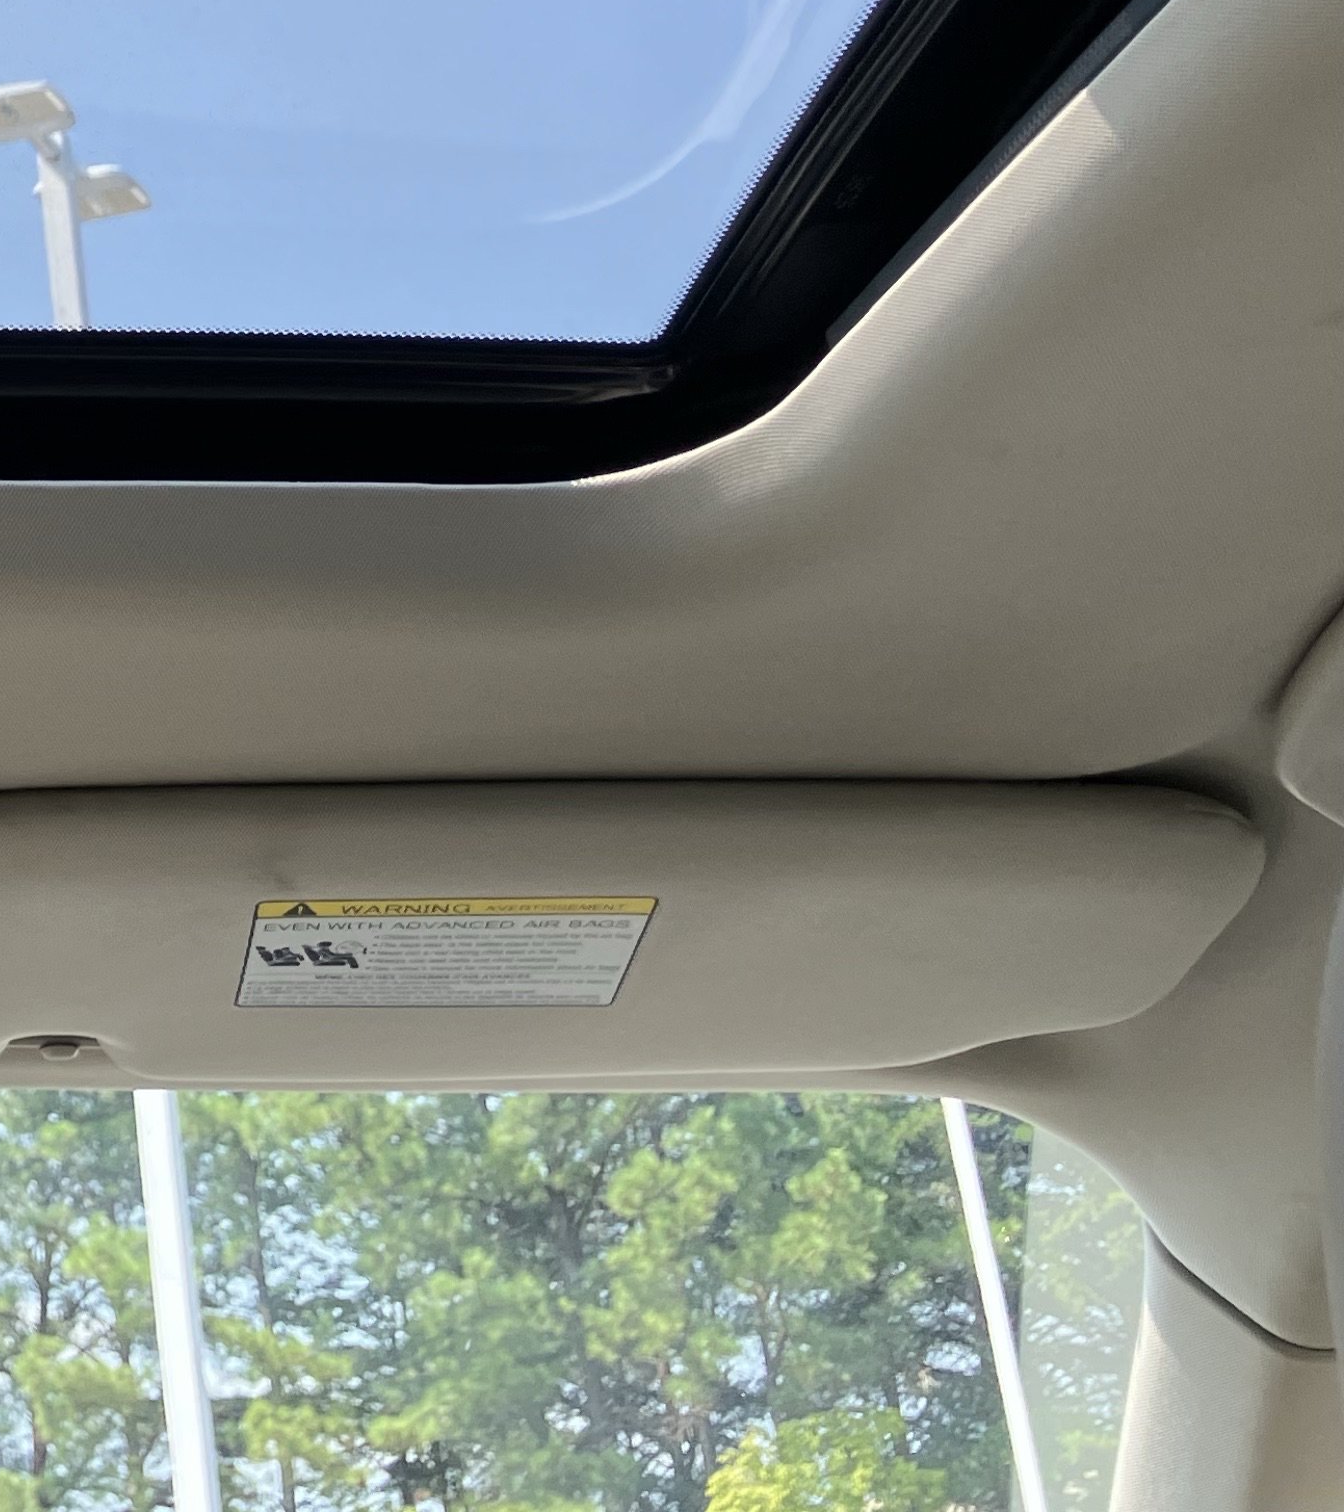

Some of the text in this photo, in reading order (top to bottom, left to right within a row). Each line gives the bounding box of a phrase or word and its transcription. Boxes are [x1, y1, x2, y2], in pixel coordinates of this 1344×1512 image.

[341, 903, 472, 915] WARNING
[263, 919, 634, 933] EVEN WITH ADVANCED AIR BAGS
